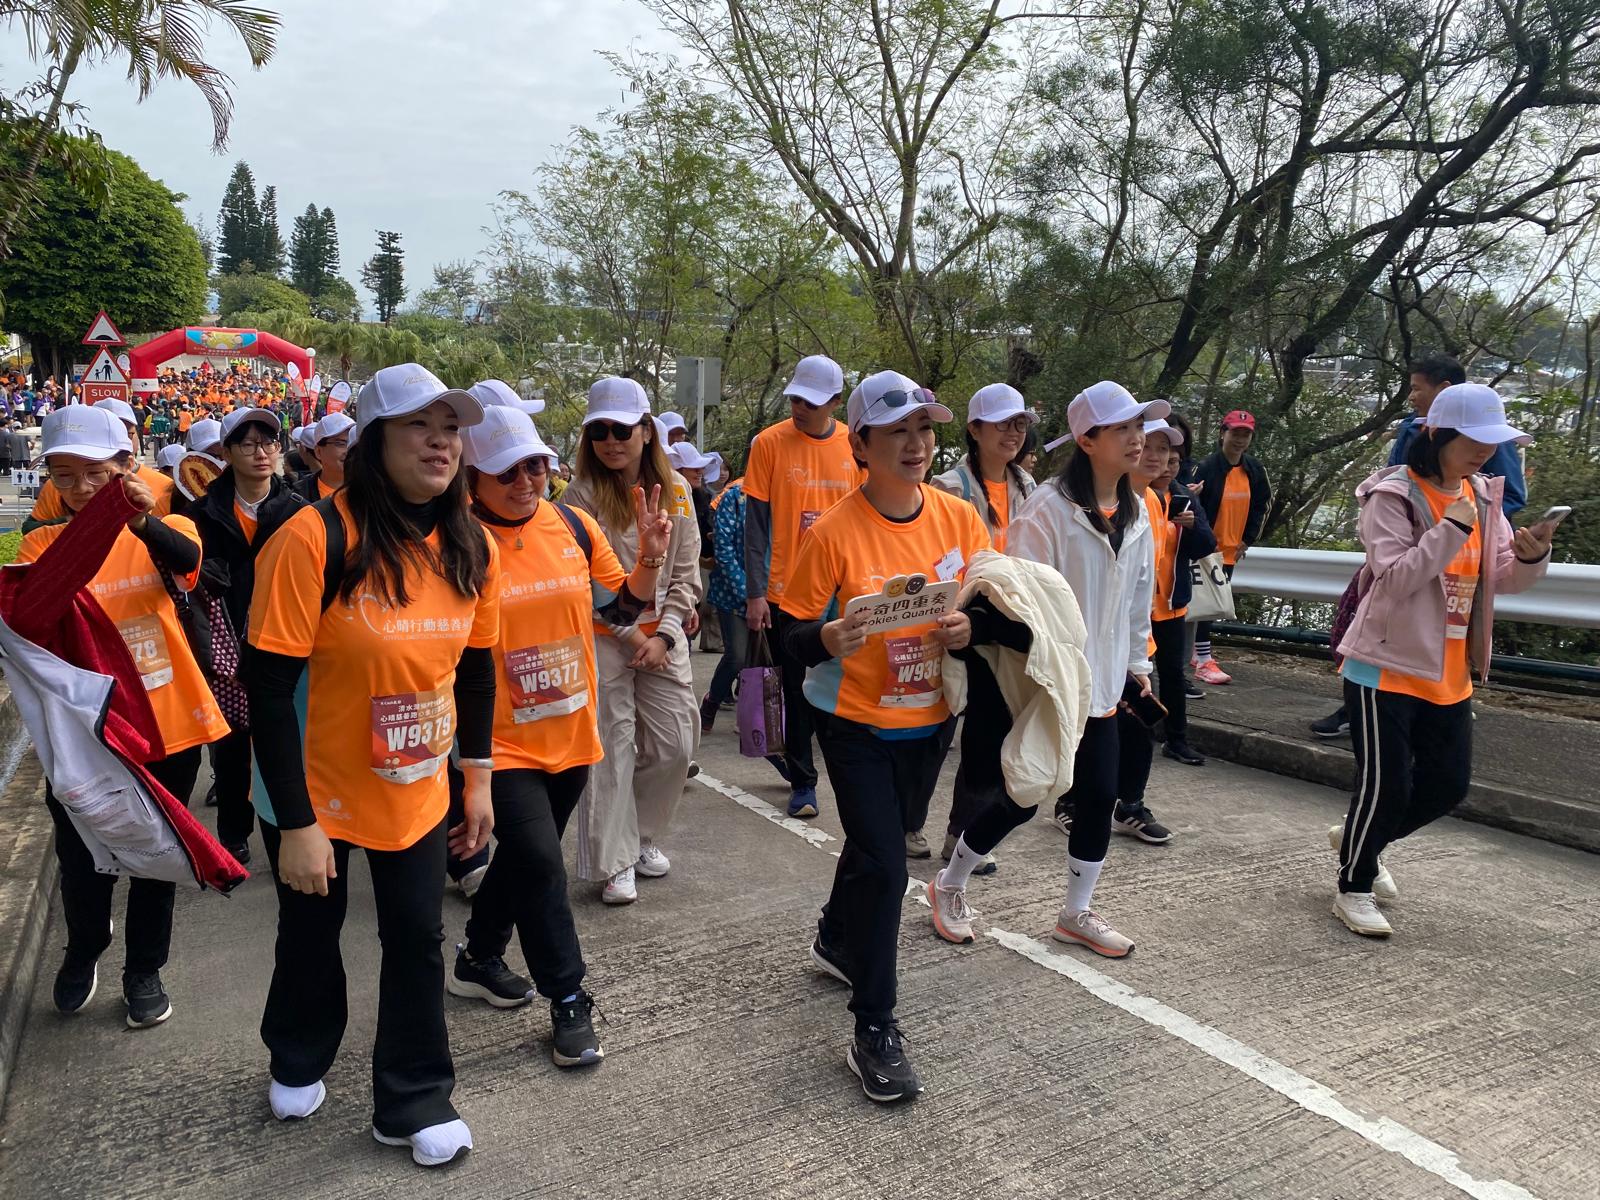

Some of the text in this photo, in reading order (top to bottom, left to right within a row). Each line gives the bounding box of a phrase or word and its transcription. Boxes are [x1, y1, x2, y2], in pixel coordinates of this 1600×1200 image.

[91, 388, 121, 397] SLOW
[854, 591, 949, 616] 奇四重奏
[902, 604, 946, 620] Quartet
[1446, 595, 1472, 614] 93
[130, 639, 158, 663] 78
[520, 660, 579, 694] W9377
[386, 712, 452, 753] W9379
